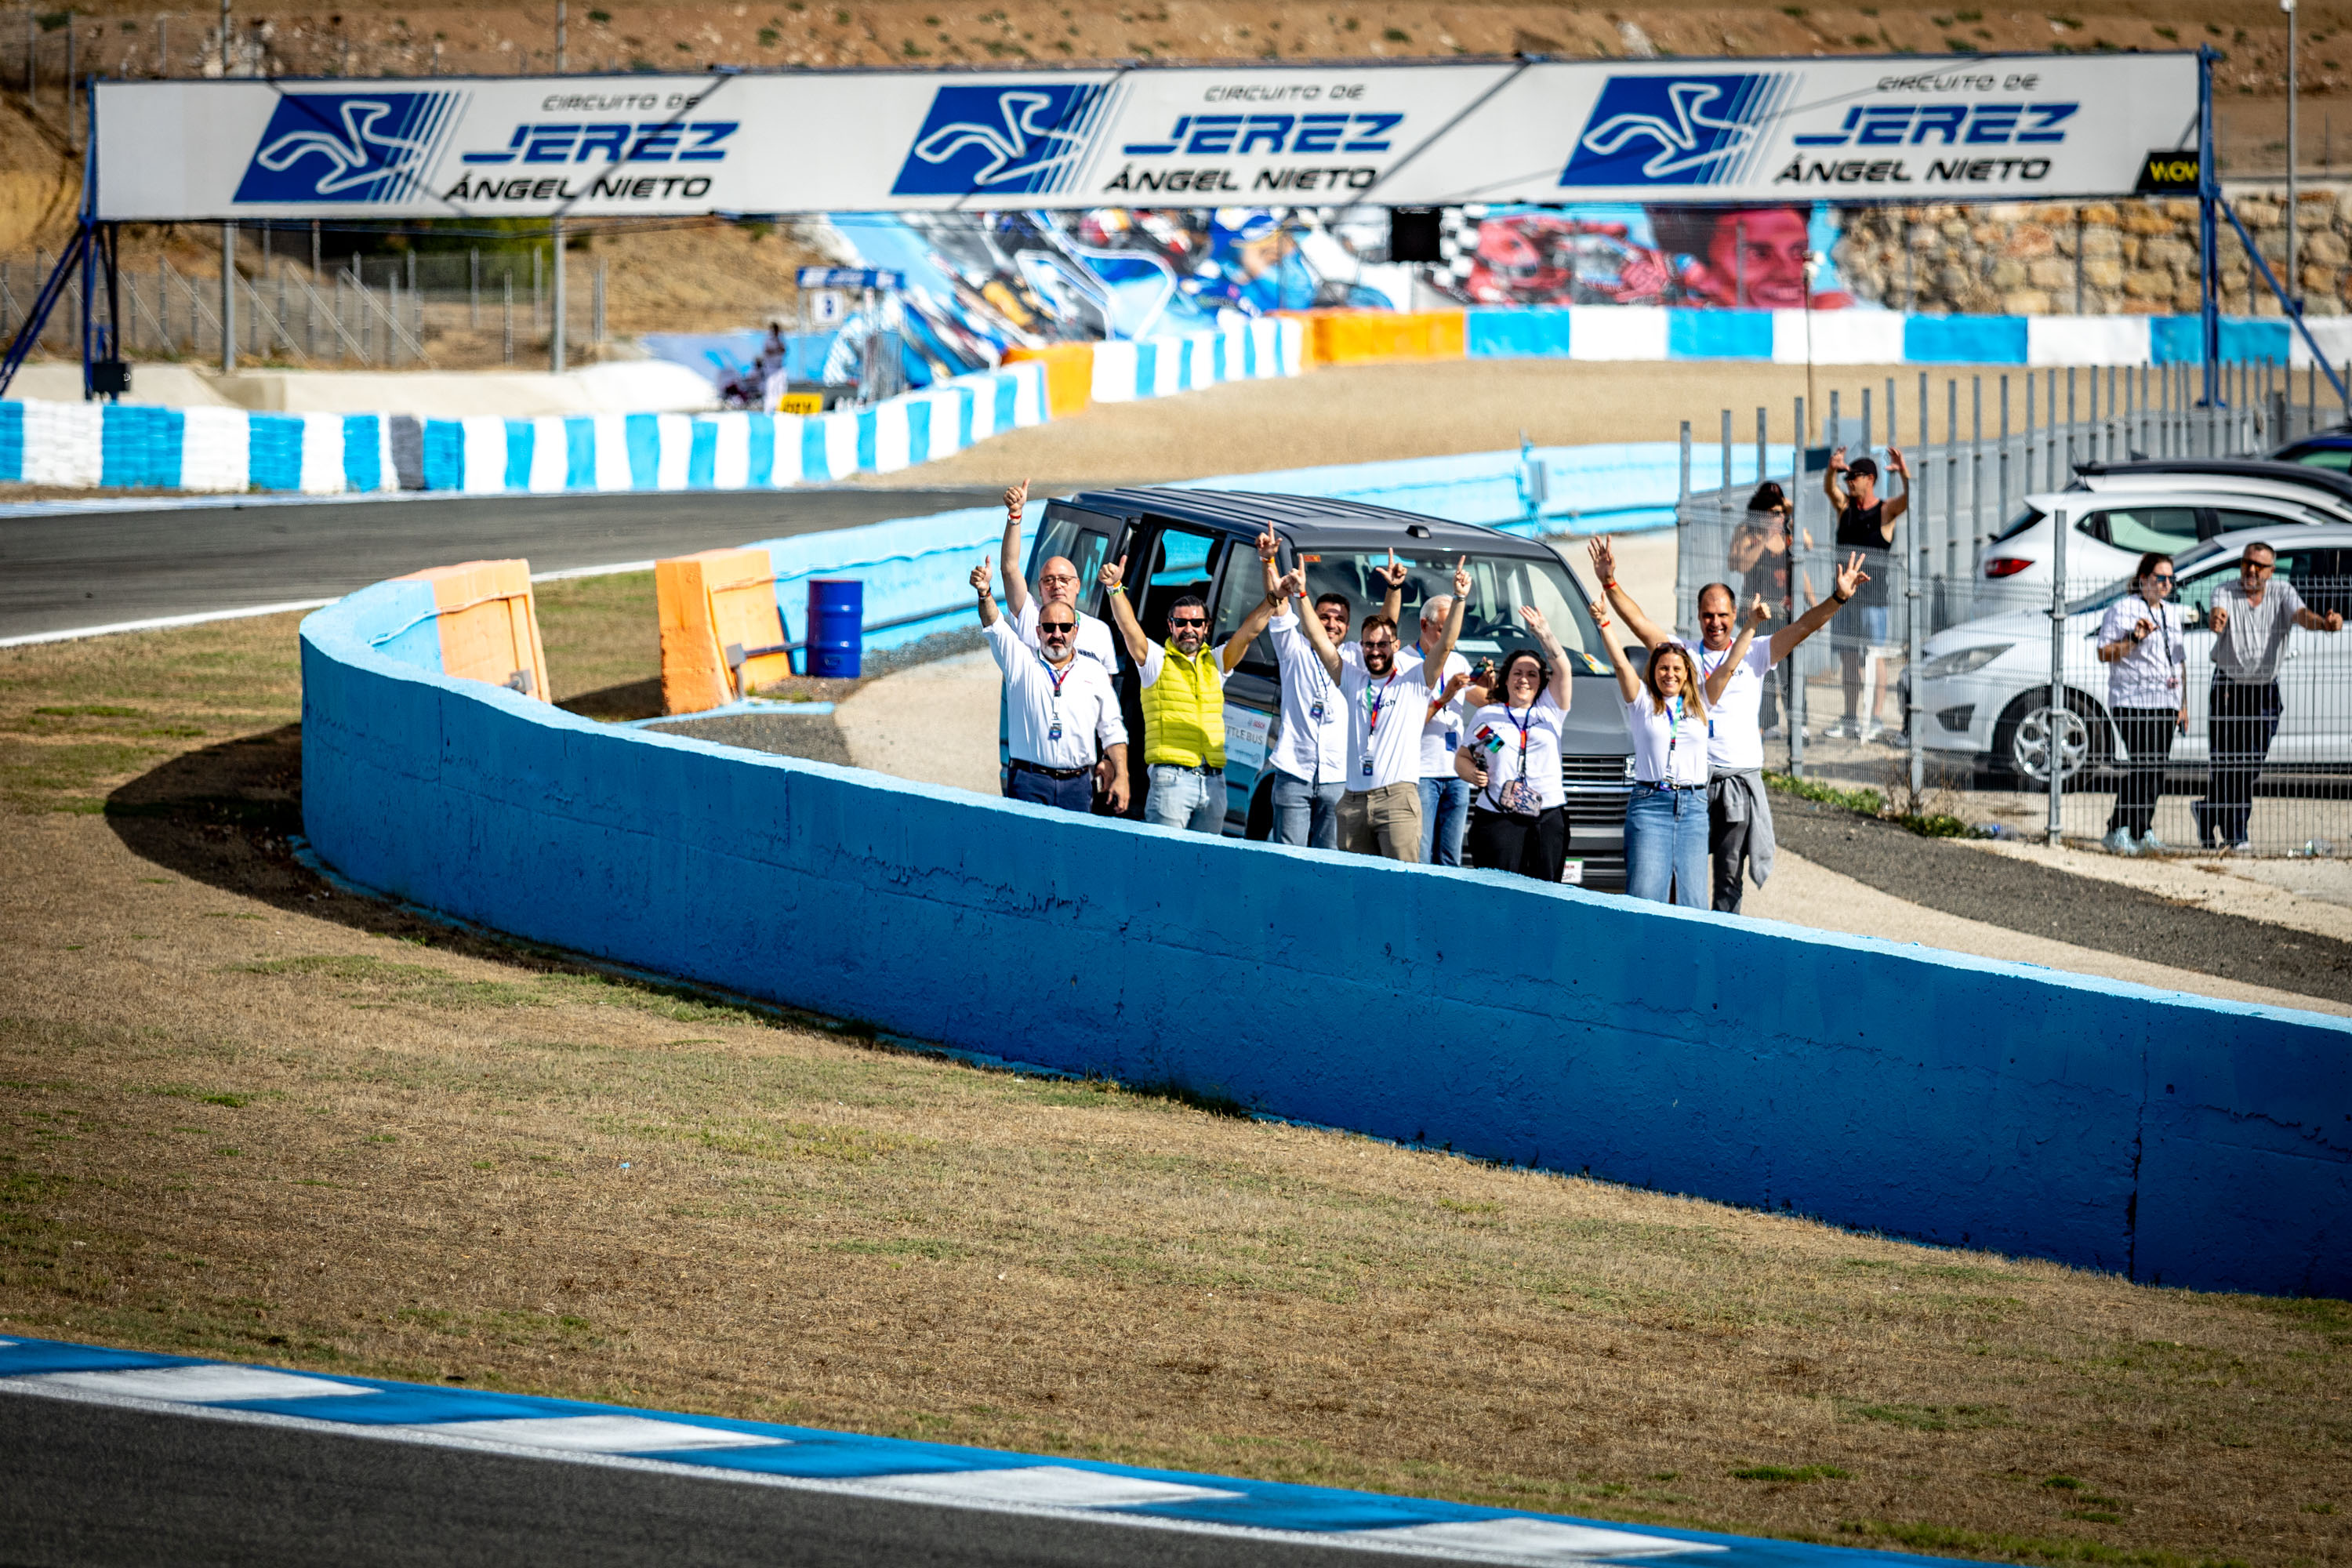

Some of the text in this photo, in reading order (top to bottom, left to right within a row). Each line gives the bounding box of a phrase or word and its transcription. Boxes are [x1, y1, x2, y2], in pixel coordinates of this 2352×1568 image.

[1203, 84, 1365, 102] CIRCUITO DE
[1876, 74, 2039, 93] CIRCUITO DE
[543, 93, 657, 111] CIRCUITO
[1123, 113, 1404, 154] JEREZ
[1793, 102, 2079, 145] JEREZ
[462, 121, 740, 163] JEREZ
[1103, 162, 1376, 193] ÁNGEL NIETO
[1773, 153, 2051, 185] ÁNGEL NIETO
[443, 170, 711, 201] ÁNGEL NIETO
[1226, 725, 1245, 740] TTLE
